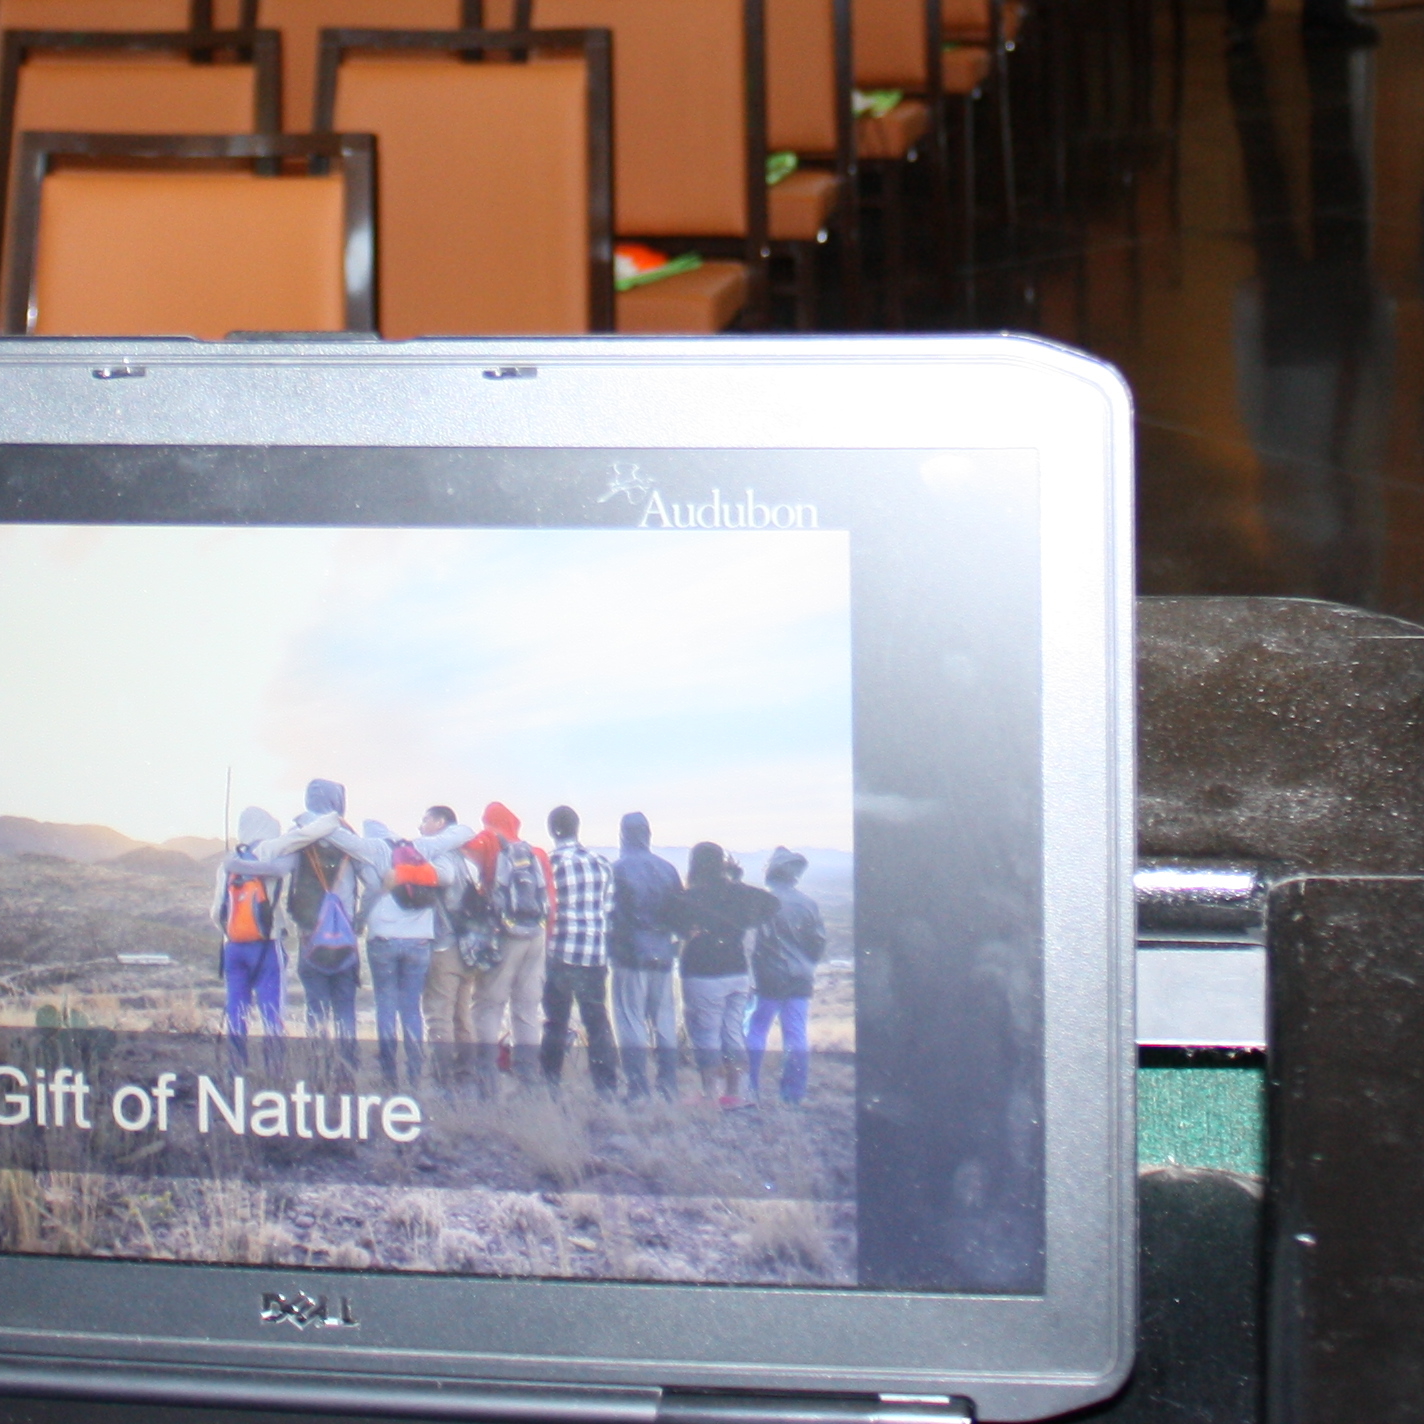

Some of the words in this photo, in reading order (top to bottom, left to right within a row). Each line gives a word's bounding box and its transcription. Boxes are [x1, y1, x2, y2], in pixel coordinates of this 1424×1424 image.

[638, 488, 820, 528] Audubon
[112, 1072, 175, 1133] of
[197, 1076, 423, 1143] Nature
[260, 1289, 361, 1331] DELL
